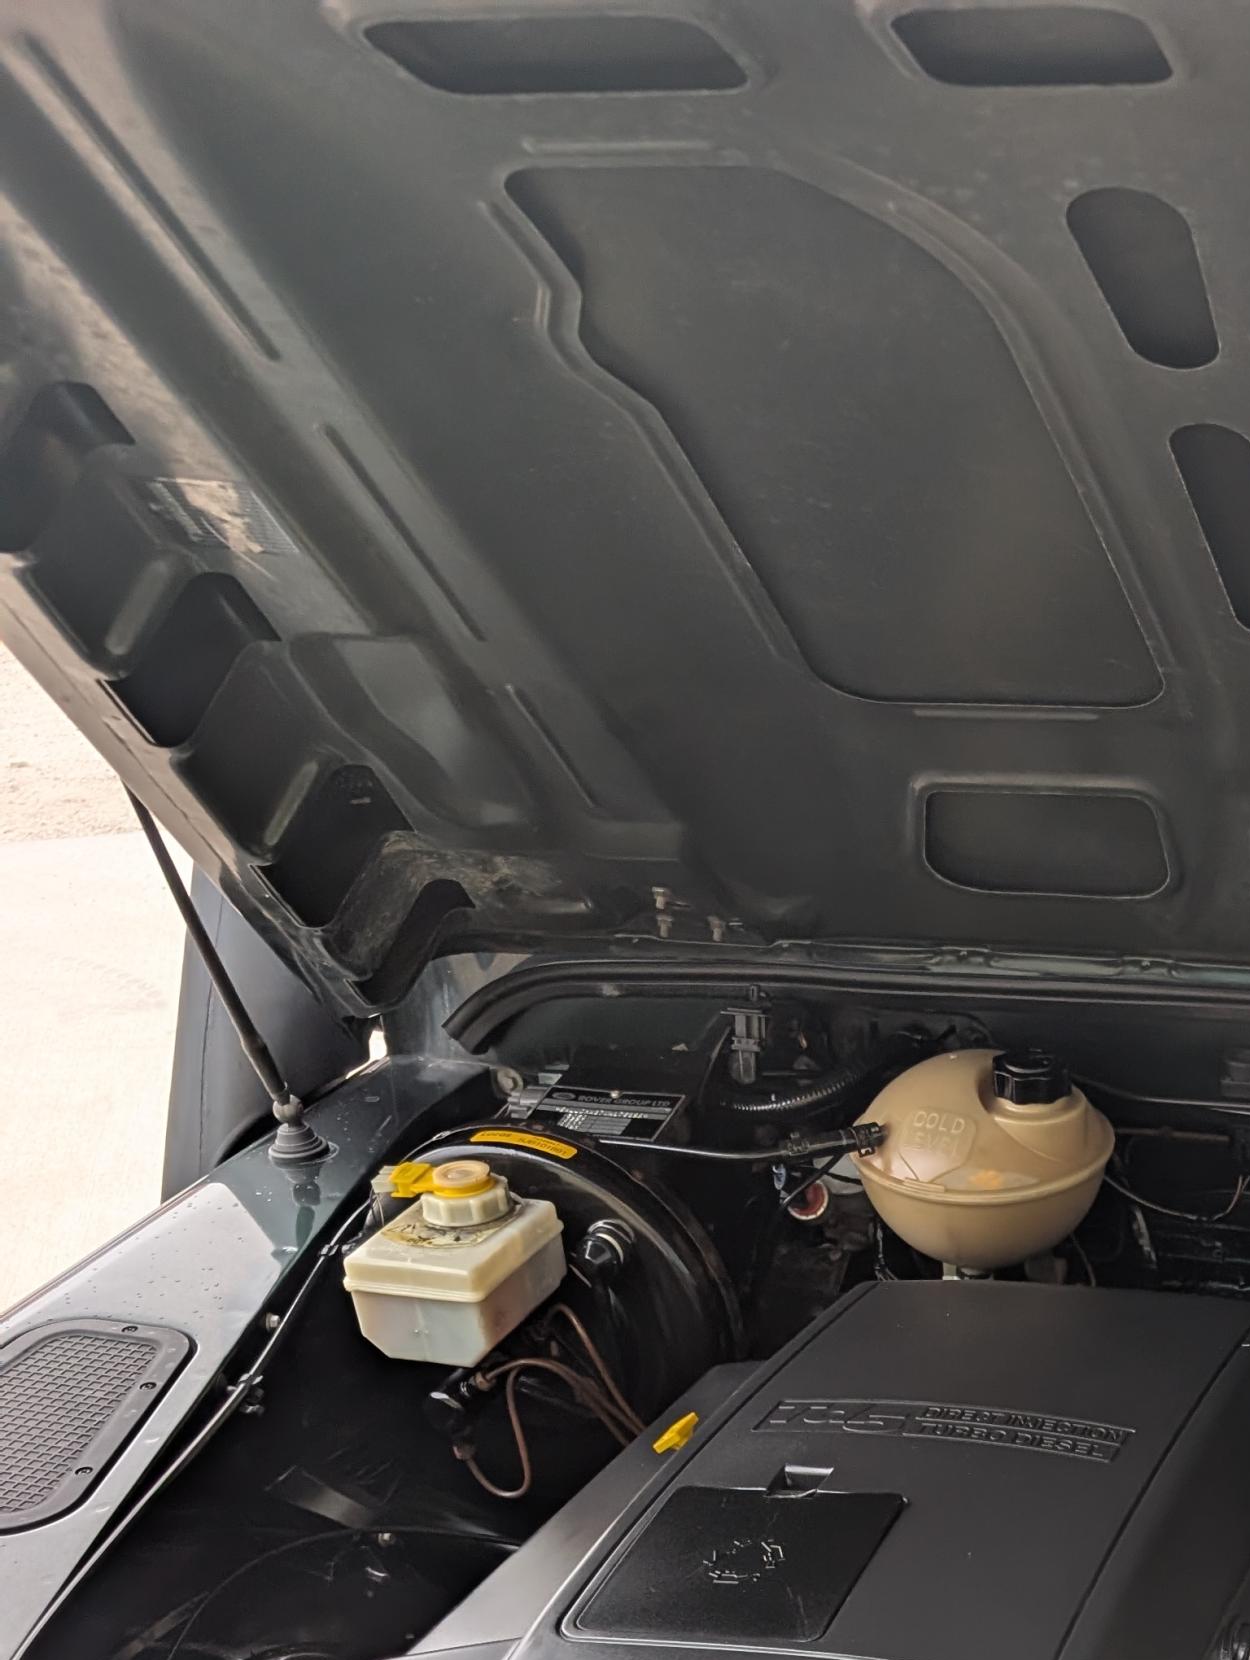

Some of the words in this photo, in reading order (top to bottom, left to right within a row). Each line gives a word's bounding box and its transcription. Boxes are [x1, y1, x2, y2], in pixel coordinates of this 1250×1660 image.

[913, 1111, 965, 1134] COLD
[921, 1422, 1007, 1441] TURBO
[1014, 1431, 1104, 1458] DIESEL
[925, 1406, 1005, 1423] DIRECT
[1007, 1413, 1126, 1442] INJECTION
